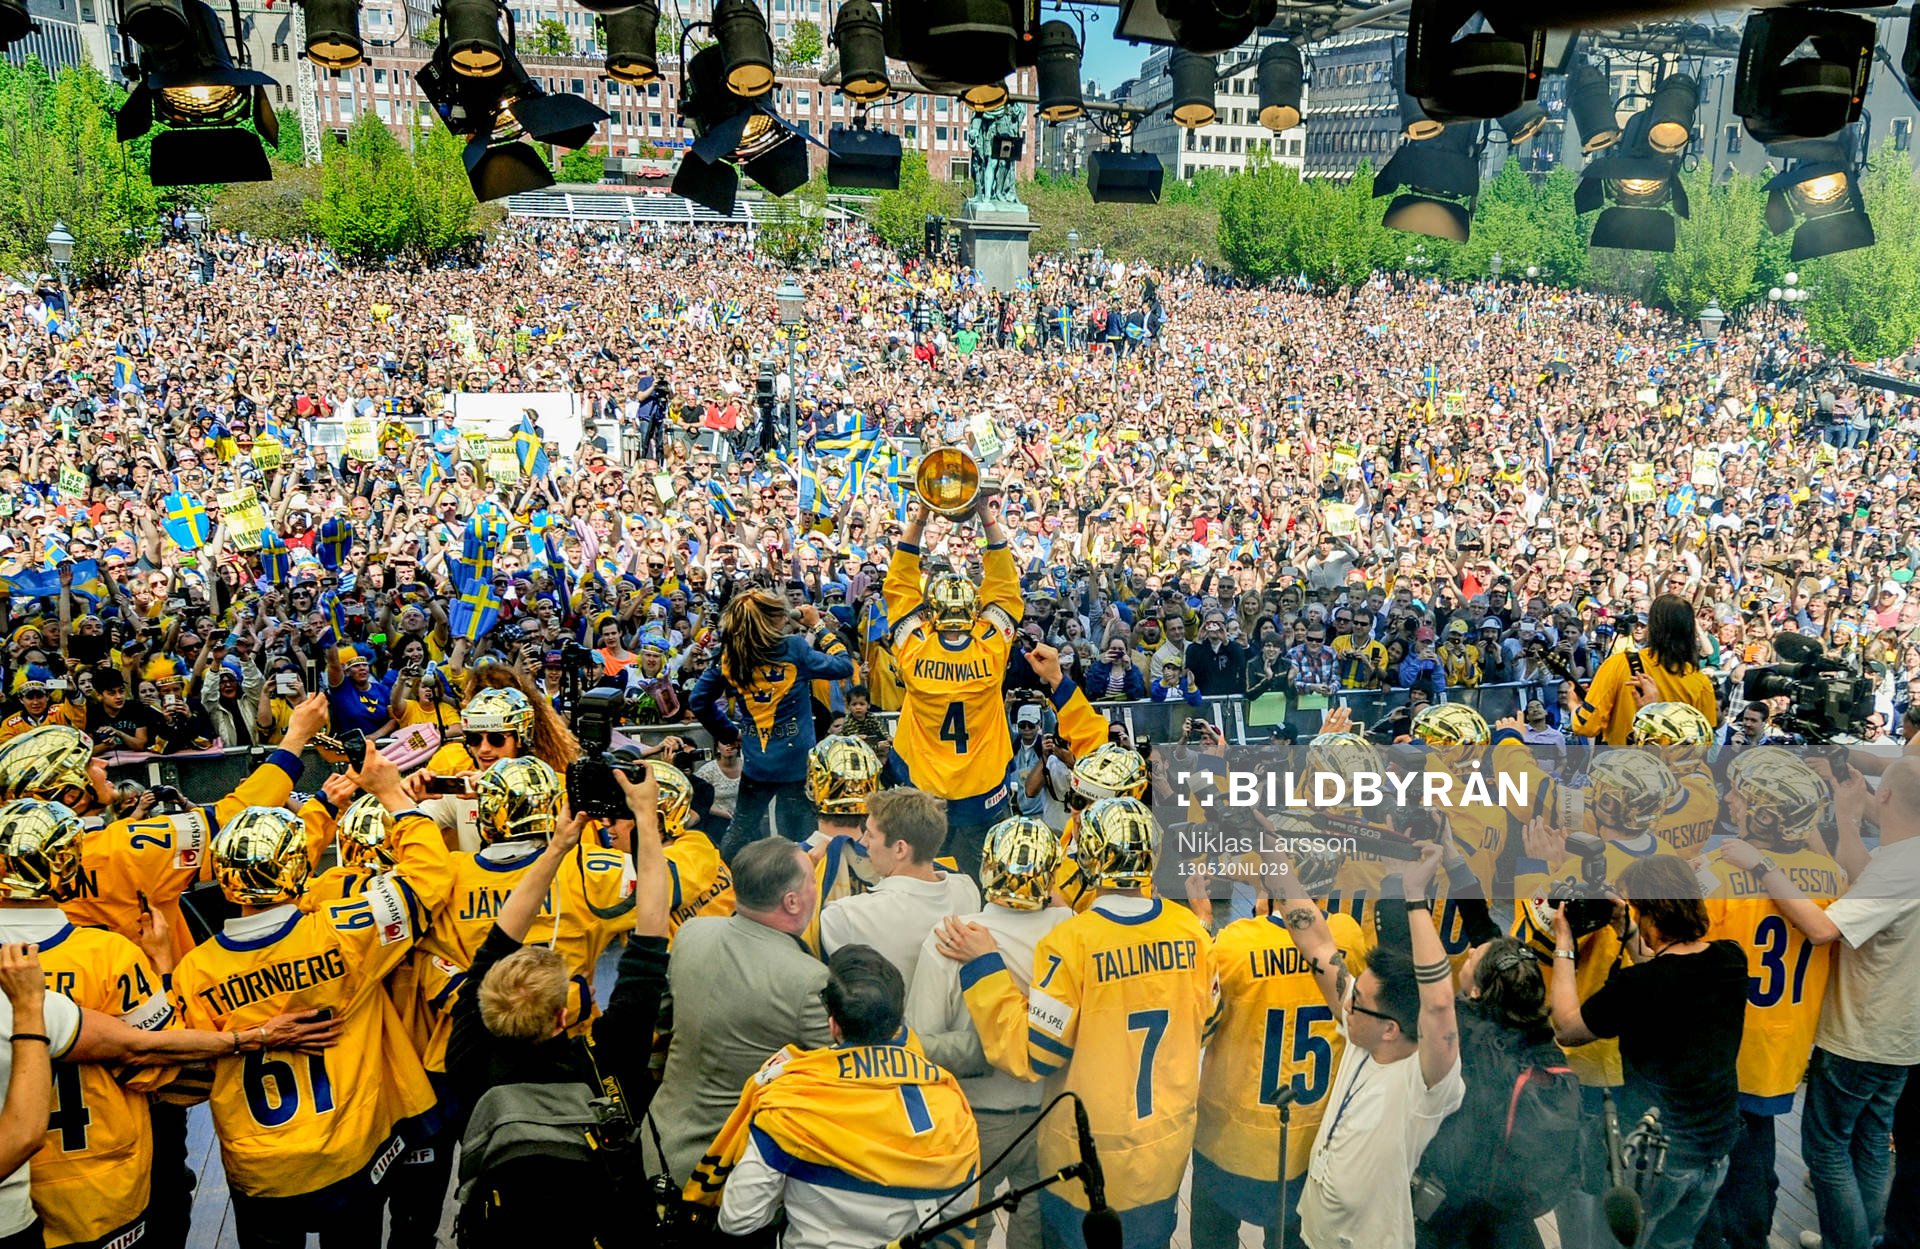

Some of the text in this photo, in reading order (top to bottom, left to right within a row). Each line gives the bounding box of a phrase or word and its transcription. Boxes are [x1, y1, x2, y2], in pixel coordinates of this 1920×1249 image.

[914, 658, 992, 682] KRONWALL
[940, 701, 969, 754] 4
[128, 823, 171, 849] 21
[382, 889, 401, 921] SVENSKA
[1039, 954, 1062, 989] 7
[1092, 940, 1196, 983] TALLINDER
[117, 962, 153, 1013] 24
[199, 948, 346, 1016] THÖRNBERG
[132, 1006, 168, 1030] VENSKA
[1048, 1015, 1064, 1031] SPEL
[837, 1046, 941, 1082] ENROTH
[1127, 1008, 1170, 1120] 7
[1258, 1005, 1335, 1107] 15
[377, 1139, 401, 1173] IIHF
